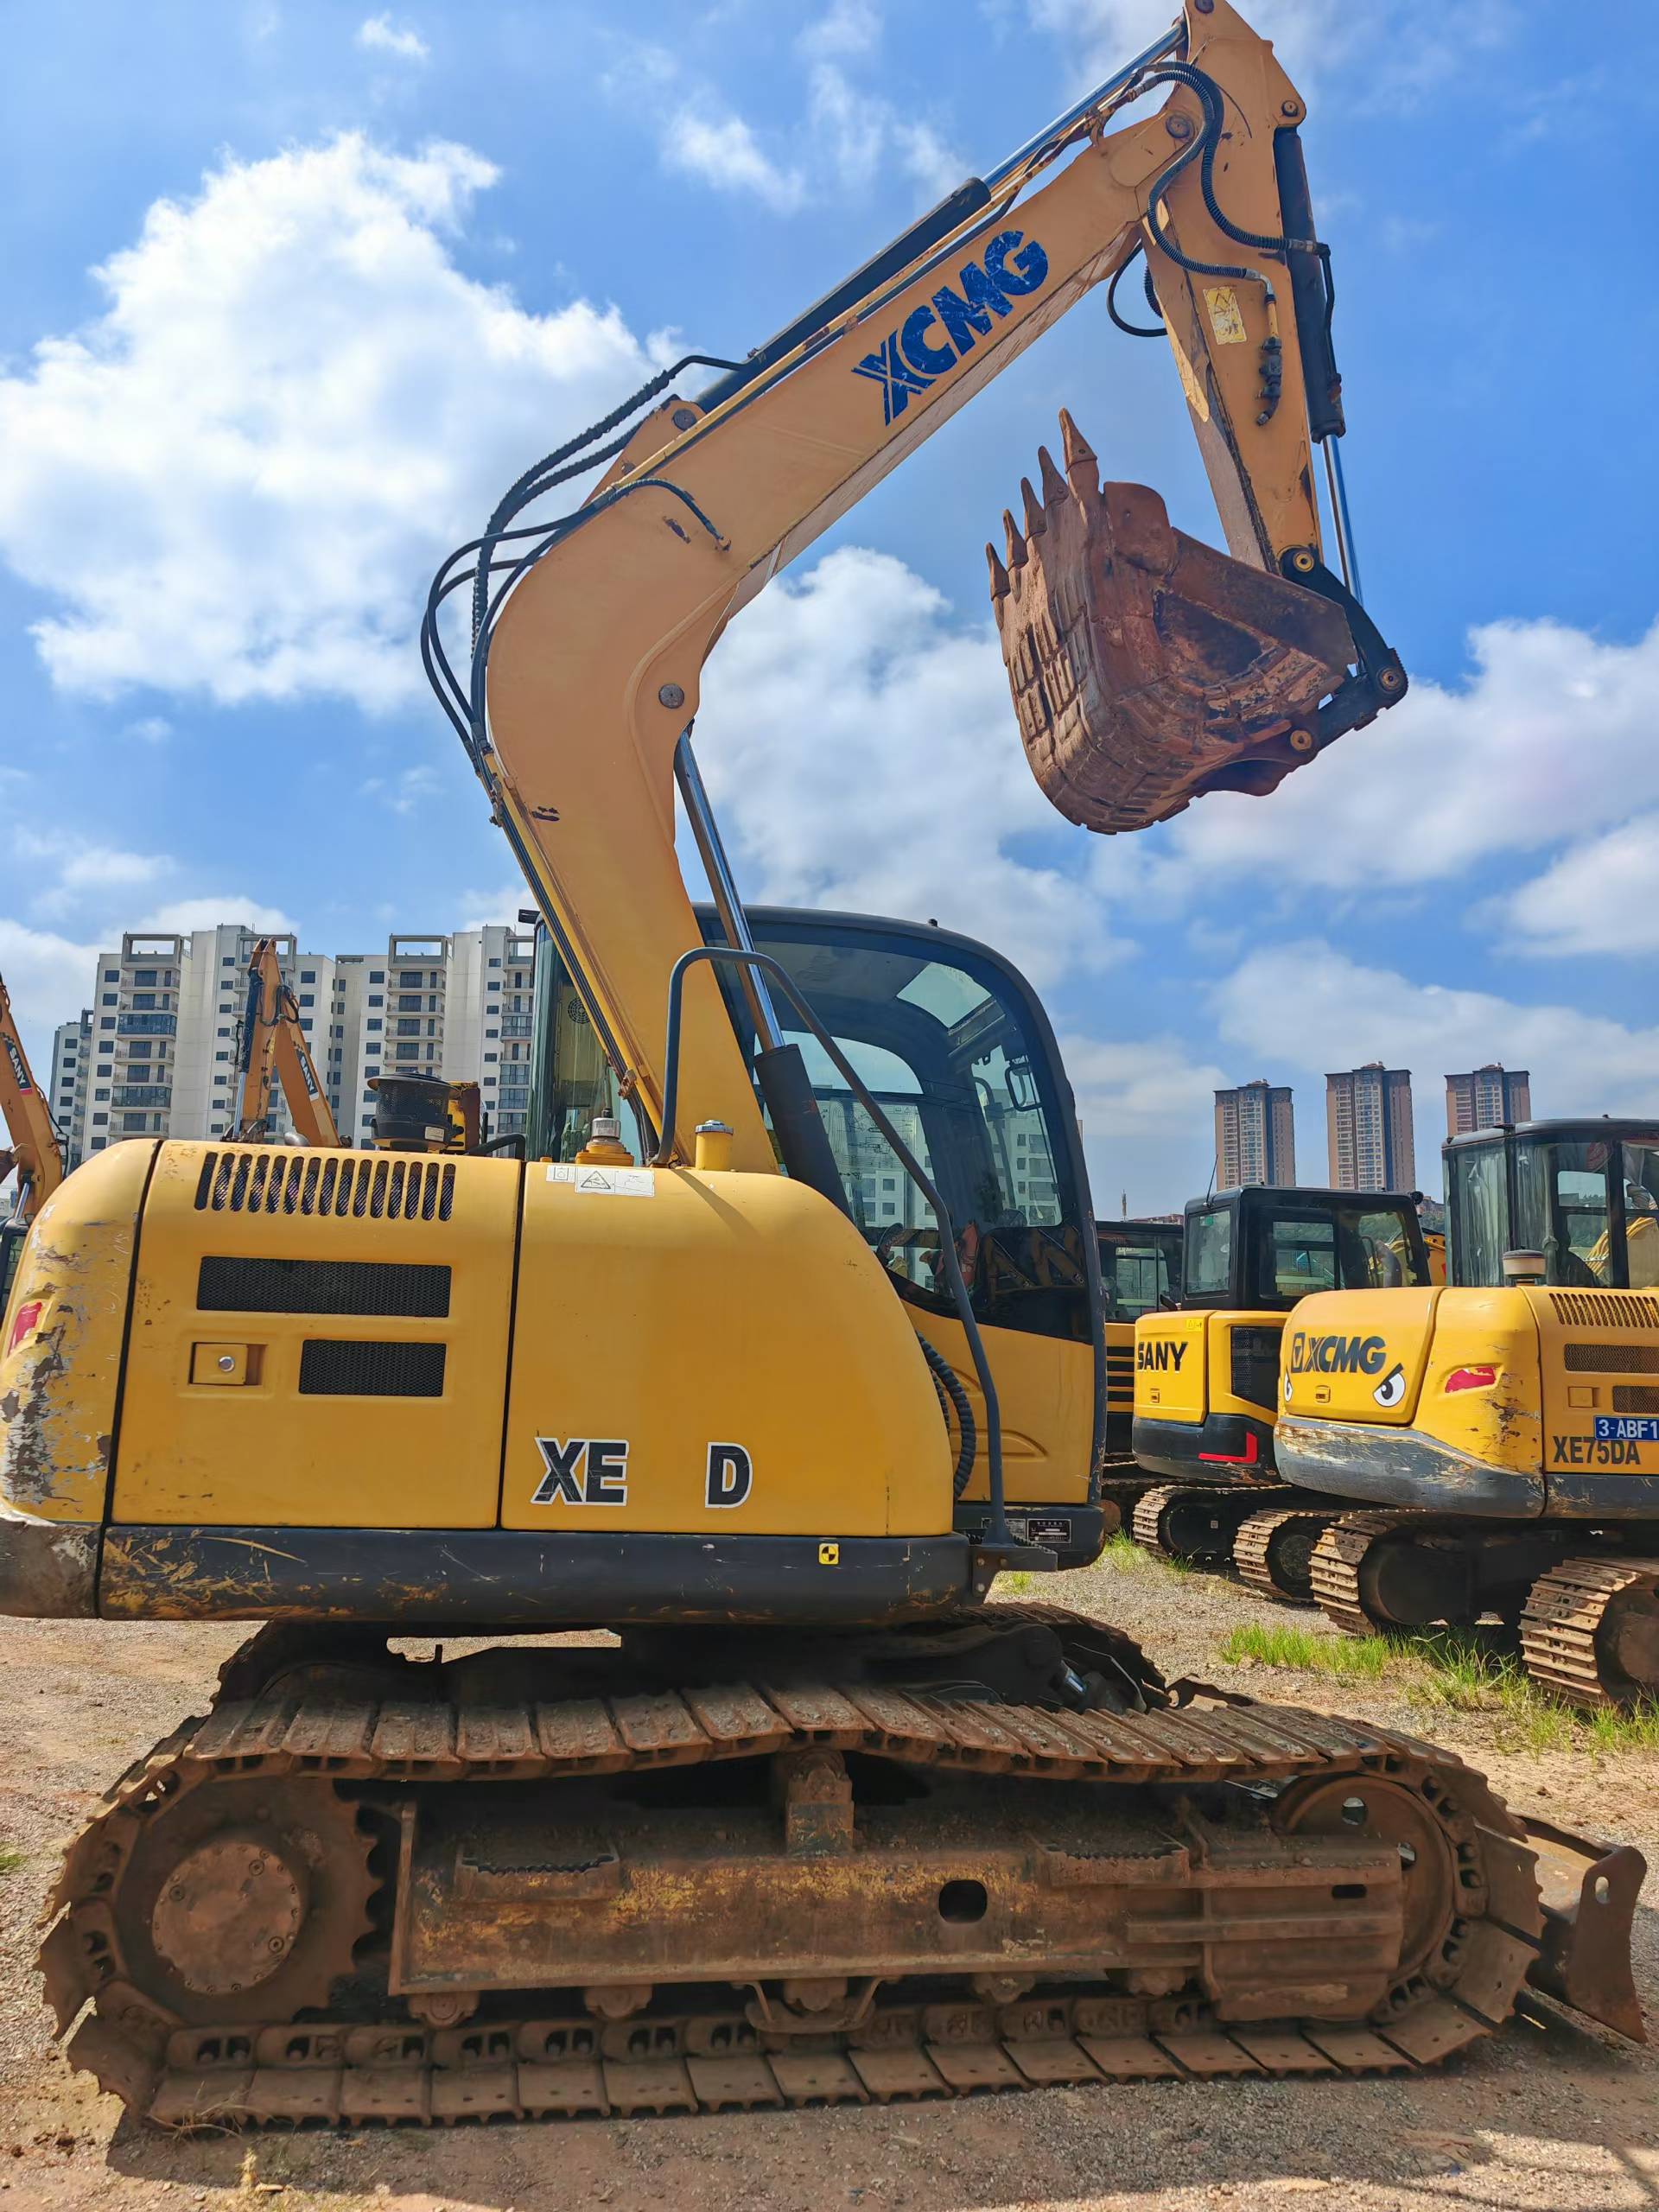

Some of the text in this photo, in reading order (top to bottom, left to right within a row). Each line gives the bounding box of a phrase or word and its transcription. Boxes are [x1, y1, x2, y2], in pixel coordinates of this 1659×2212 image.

[851, 230, 1049, 426] XCMG
[10, 1046, 26, 1084] SANY
[300, 1055, 315, 1091] SANY
[1137, 1340, 1189, 1372] SANY
[1304, 1336, 1387, 1375] XCMG
[1599, 1419, 1657, 1440] 3-ABF1
[1553, 1435, 1641, 1465] XE75DA
[530, 1437, 753, 1508] XE D
